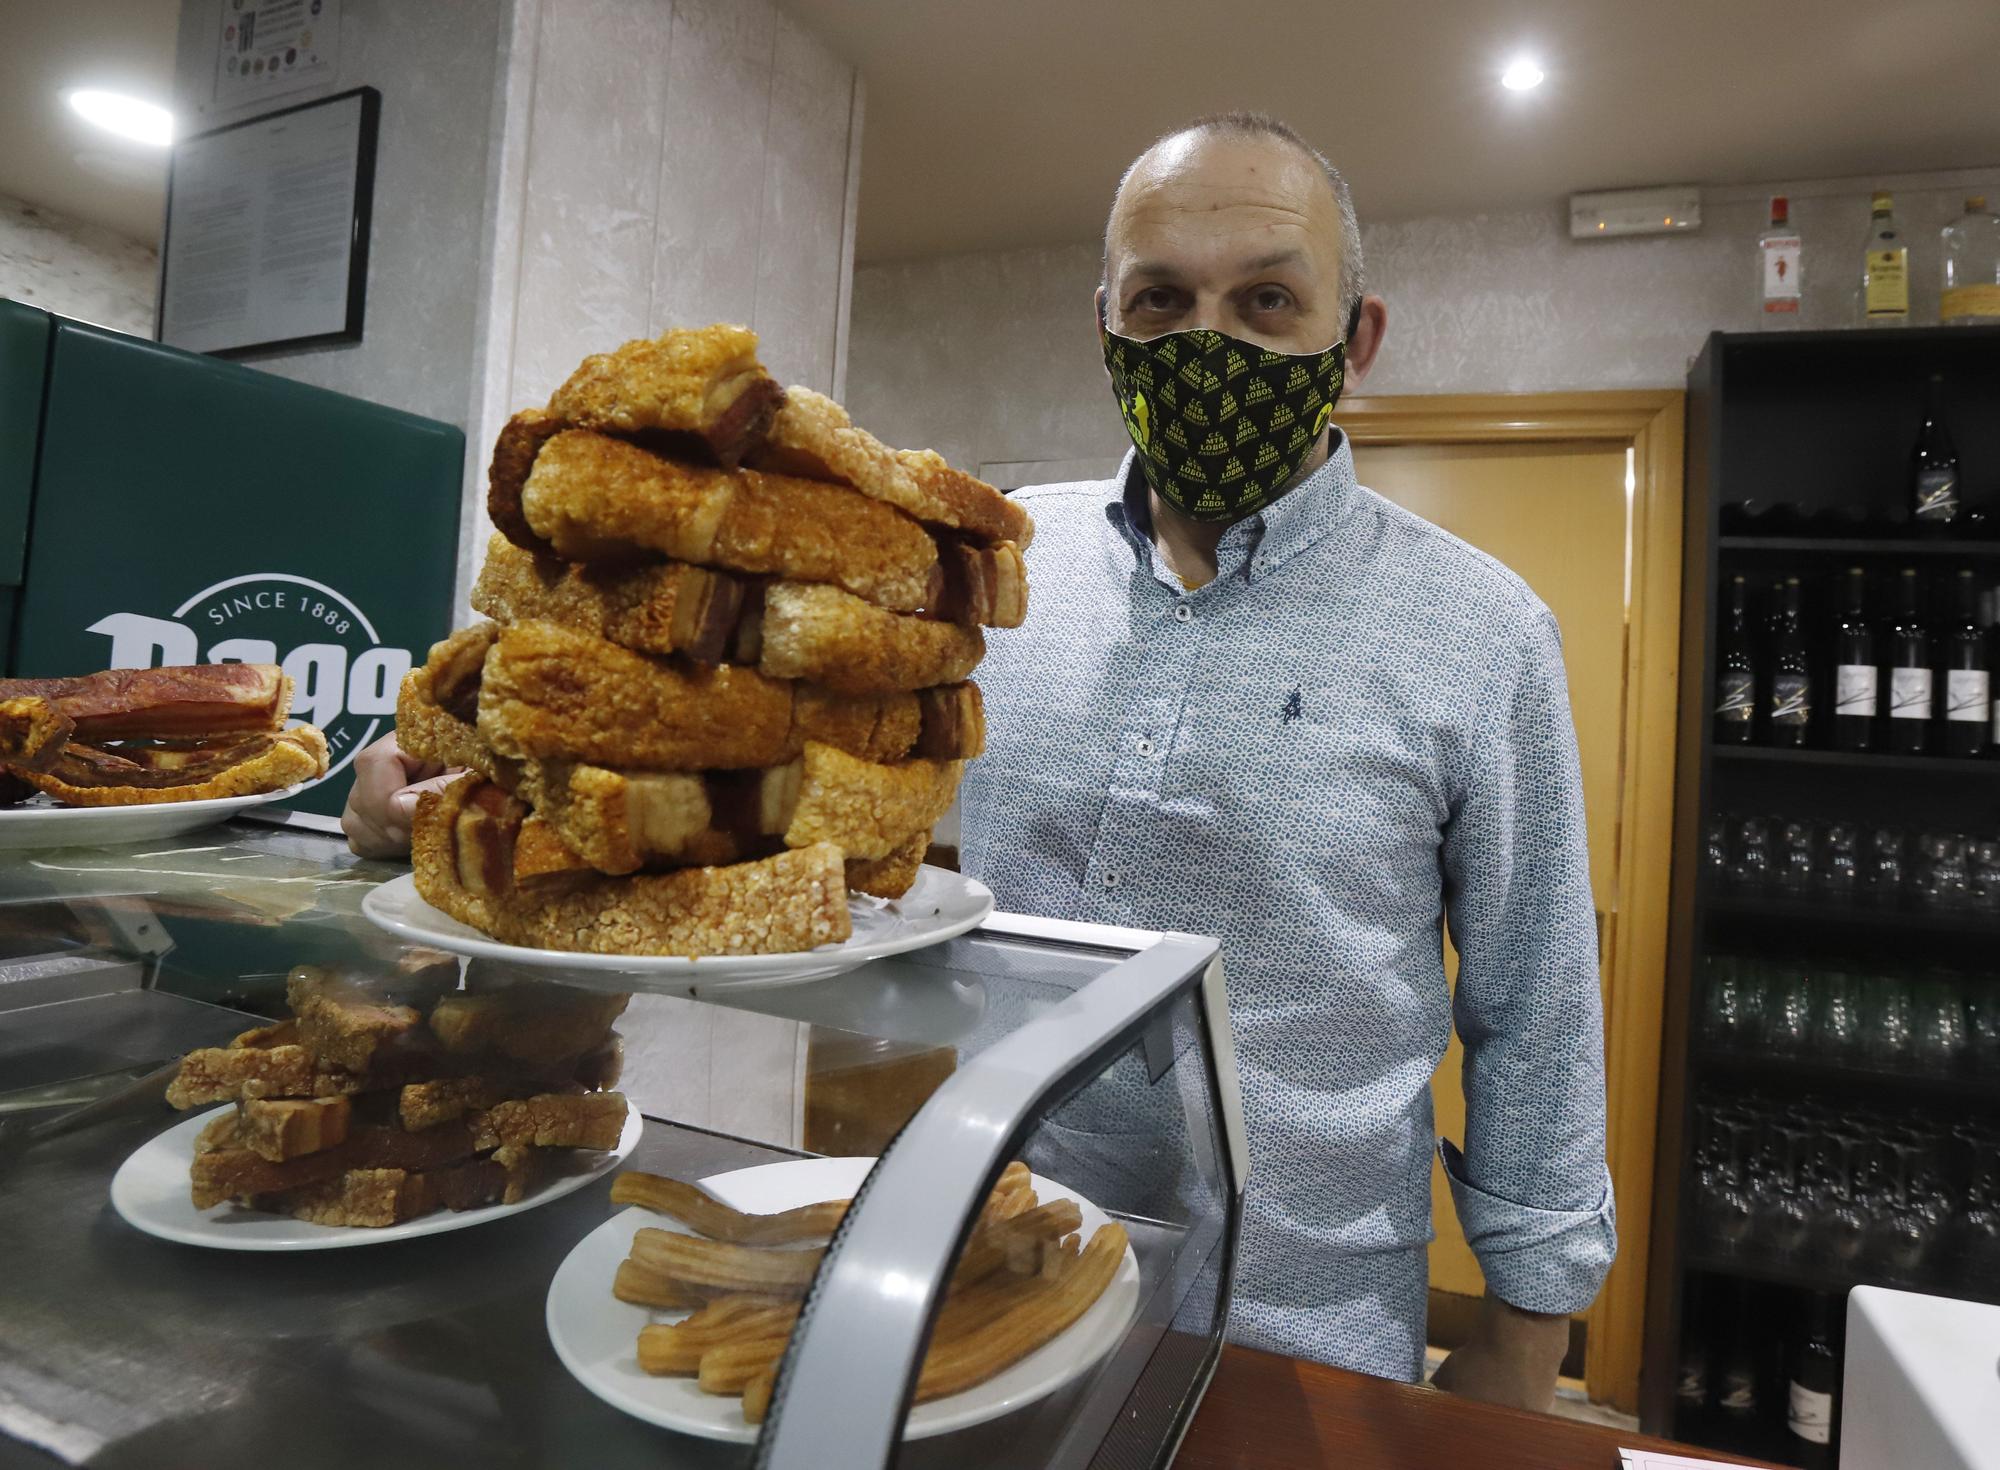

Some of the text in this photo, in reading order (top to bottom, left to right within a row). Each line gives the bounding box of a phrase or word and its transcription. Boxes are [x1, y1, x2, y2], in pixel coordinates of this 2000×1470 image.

[1286, 374, 1310, 389] LOBOS
[1245, 386, 1273, 401] LOBOS
[1184, 407, 1209, 422] LOBOS
[1269, 412, 1295, 427] LOBOS
[1236, 425, 1258, 441] LOBOS
[1200, 440, 1228, 451] LOBOS
[1255, 450, 1279, 465] LOBOS
[1221, 464, 1244, 479] LOBOS
[1197, 499, 1226, 507] LOBOS
[1202, 493, 1222, 501] MTB
[208, 592, 350, 634] SINCE 1888
